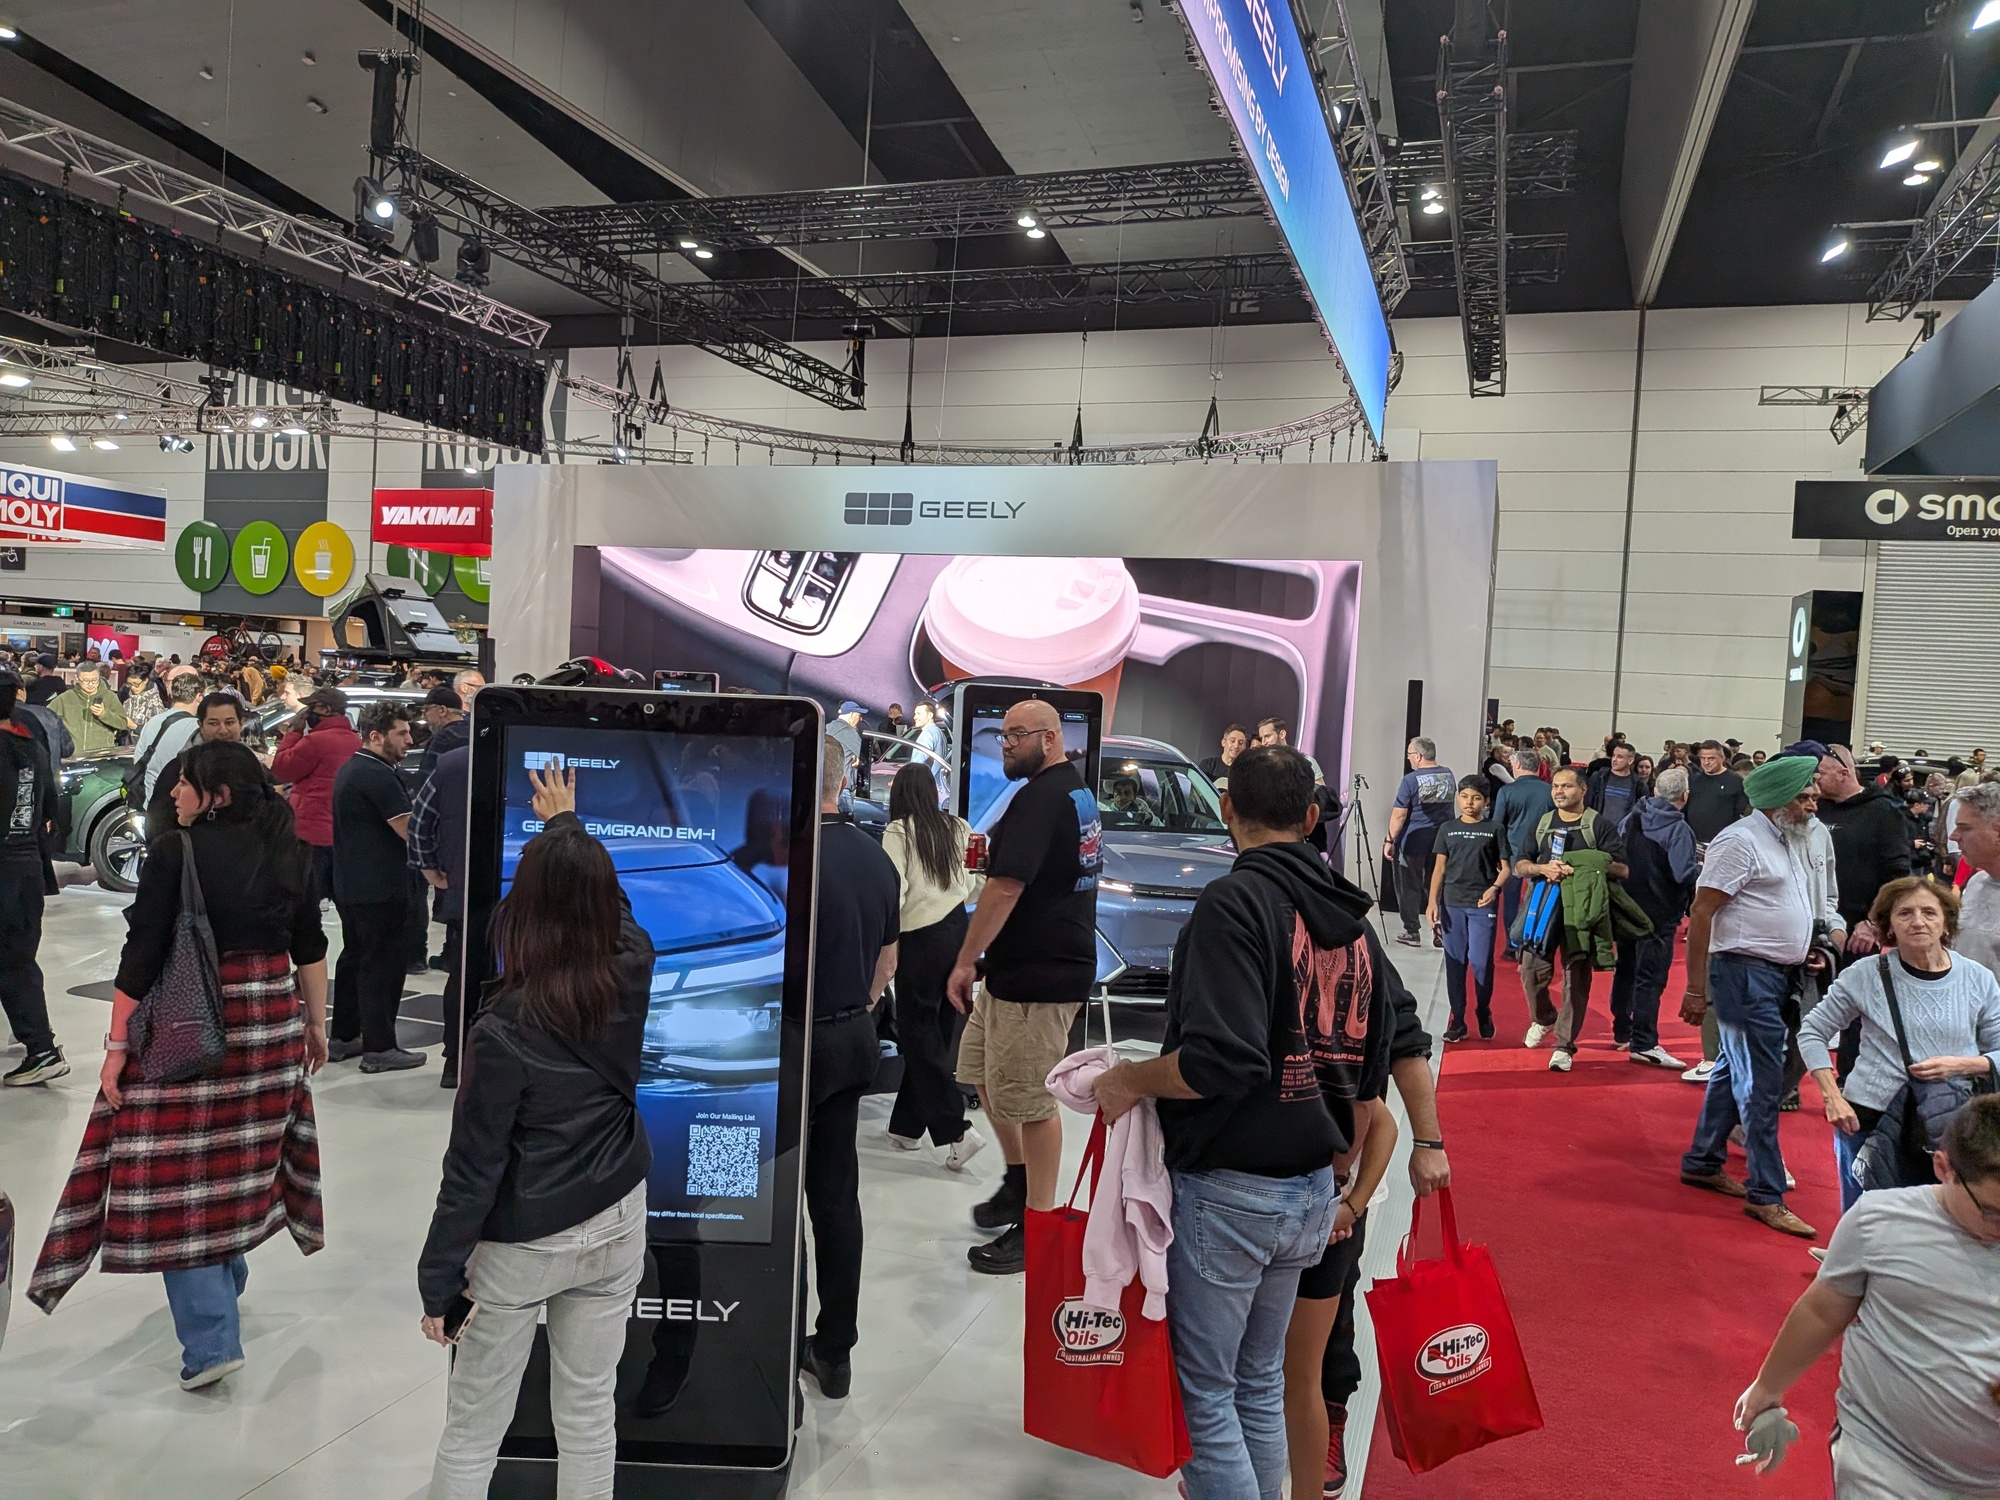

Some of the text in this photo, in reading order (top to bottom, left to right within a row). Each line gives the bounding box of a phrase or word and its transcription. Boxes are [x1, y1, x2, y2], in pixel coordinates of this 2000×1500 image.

[1245, 0, 1288, 97] EELY
[1255, 103, 1267, 144] BY
[1266, 130, 1290, 203] DESIGN
[0, 471, 59, 502] IQUI
[381, 506, 476, 526] YAKIMA
[919, 501, 1027, 519] GEELY
[1947, 525, 1979, 538] Open
[567, 757, 620, 769] GEELY
[585, 823, 673, 839] EMGRAND
[722, 1113, 743, 1121] Mailing
[705, 1212, 744, 1220] specifications.
[626, 1298, 740, 1322] EELY
[1066, 1311, 1121, 1329] Hi-Tec
[1066, 1330, 1099, 1345] Oils
[1443, 1332, 1483, 1356] Hi-Tec
[1102, 1353, 1121, 1361] OWNED
[1446, 1353, 1472, 1370] Oils
[1447, 1369, 1476, 1385] AUSTRALIAN
